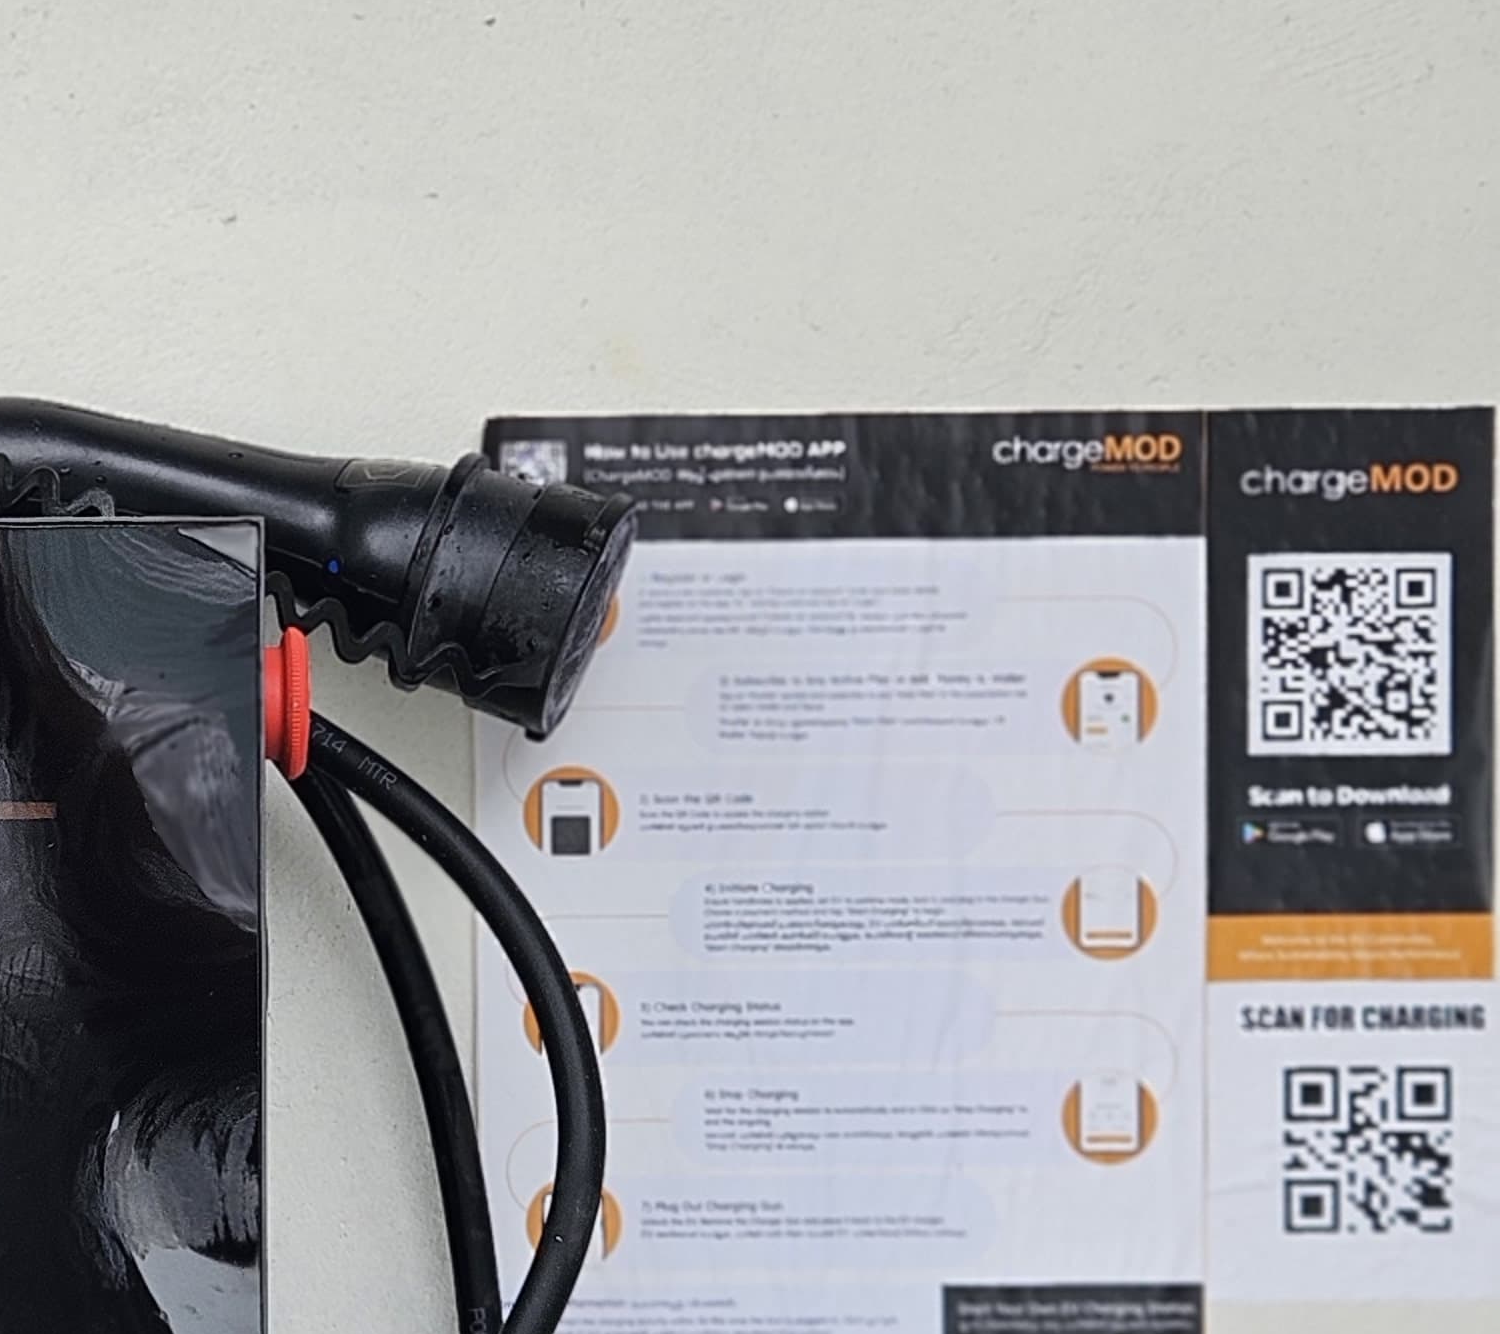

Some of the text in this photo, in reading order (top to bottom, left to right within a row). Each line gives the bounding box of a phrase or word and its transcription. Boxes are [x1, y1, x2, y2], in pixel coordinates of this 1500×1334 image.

[807, 441, 847, 458] APP
[991, 434, 1183, 471] chargeMOD
[1238, 463, 1460, 501] chargeMOD
[357, 755, 399, 790] MTR
[1248, 783, 1451, 807] Scan to Download
[1240, 1005, 1486, 1031] SCAN FOR CHARGING
